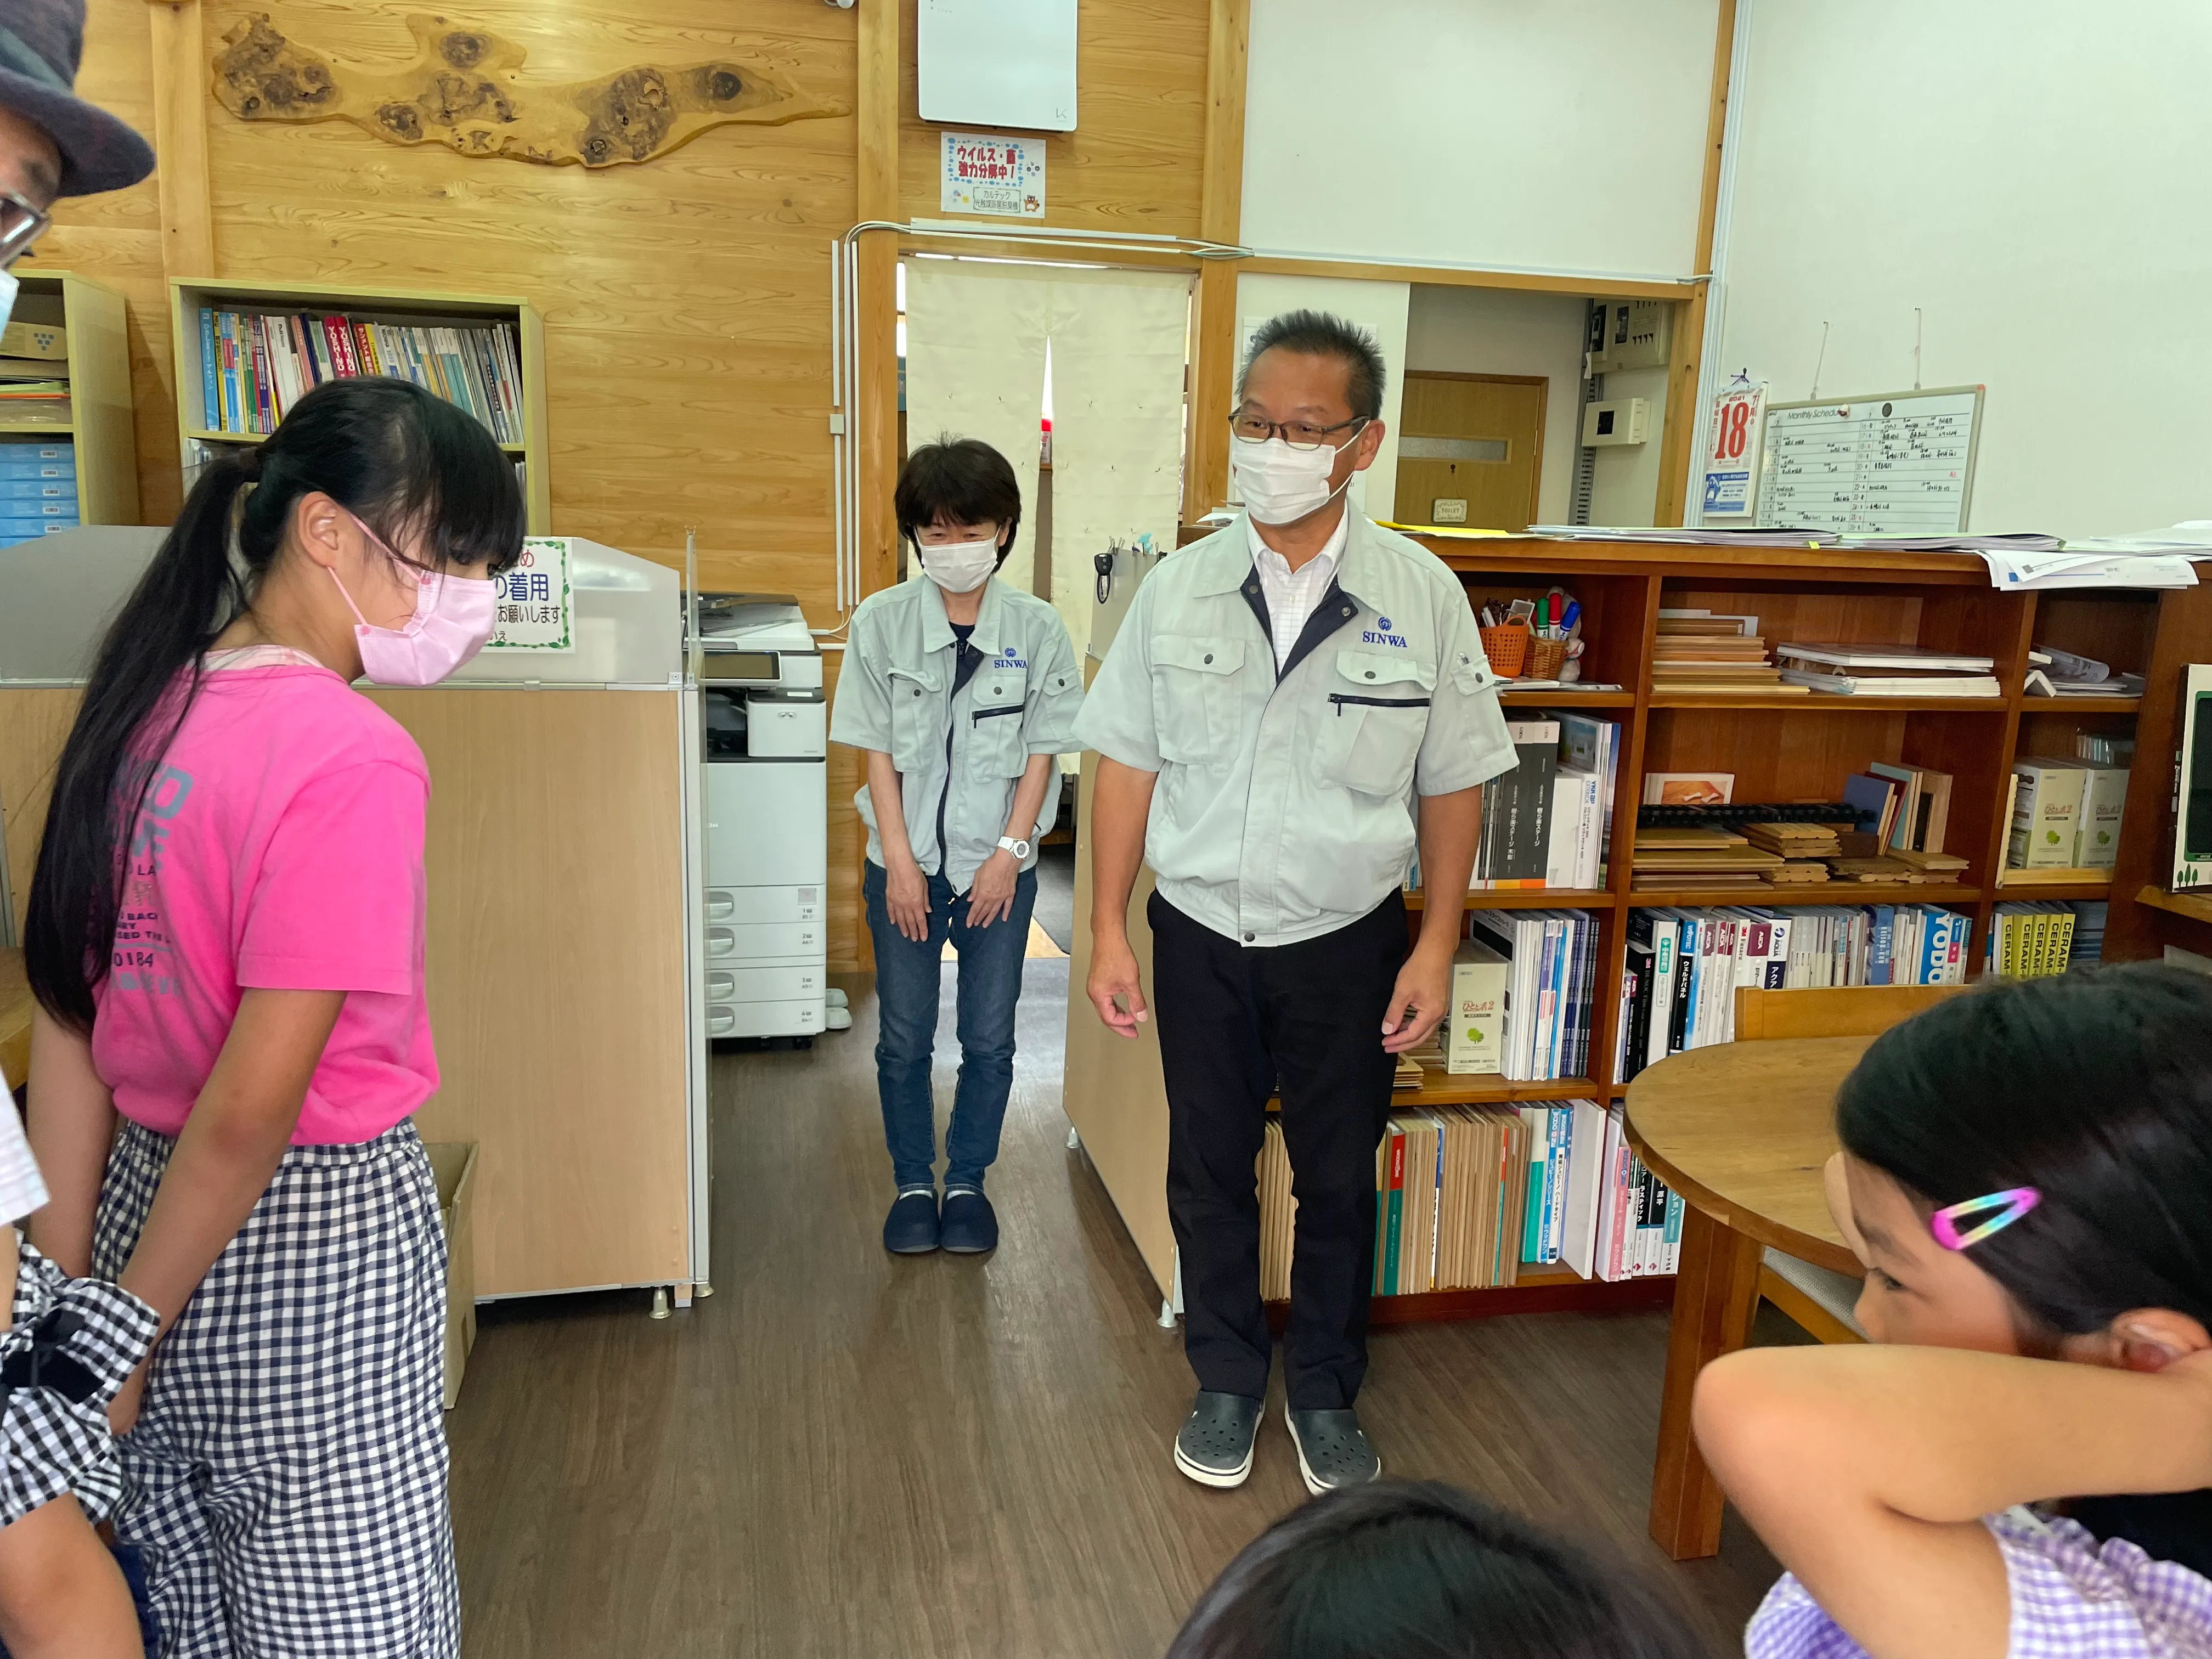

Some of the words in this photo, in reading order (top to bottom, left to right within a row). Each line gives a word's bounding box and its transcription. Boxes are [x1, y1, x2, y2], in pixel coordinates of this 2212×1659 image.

[957, 145, 1016, 165] ウイルス・菌
[983, 190, 1011, 200] カルテック
[328, 326, 345, 371] YOSHINO
[339, 326, 356, 371] YOSHINO
[1787, 410, 1812, 420] Monthly
[1813, 408, 1838, 417] Schedu
[1715, 402, 1750, 459] 18
[495, 603, 561, 624] お願いします
[1362, 630, 1408, 648] SINWA
[994, 659, 1028, 669] SINWA
[1742, 926, 1748, 936] 3M
[1738, 939, 1746, 960] Fasara
[1928, 912, 1950, 984] YODO
[1679, 961, 1690, 998] ウェルドパネル
[1770, 966, 1779, 988] アクア
[1671, 1193, 1679, 1216] ション
